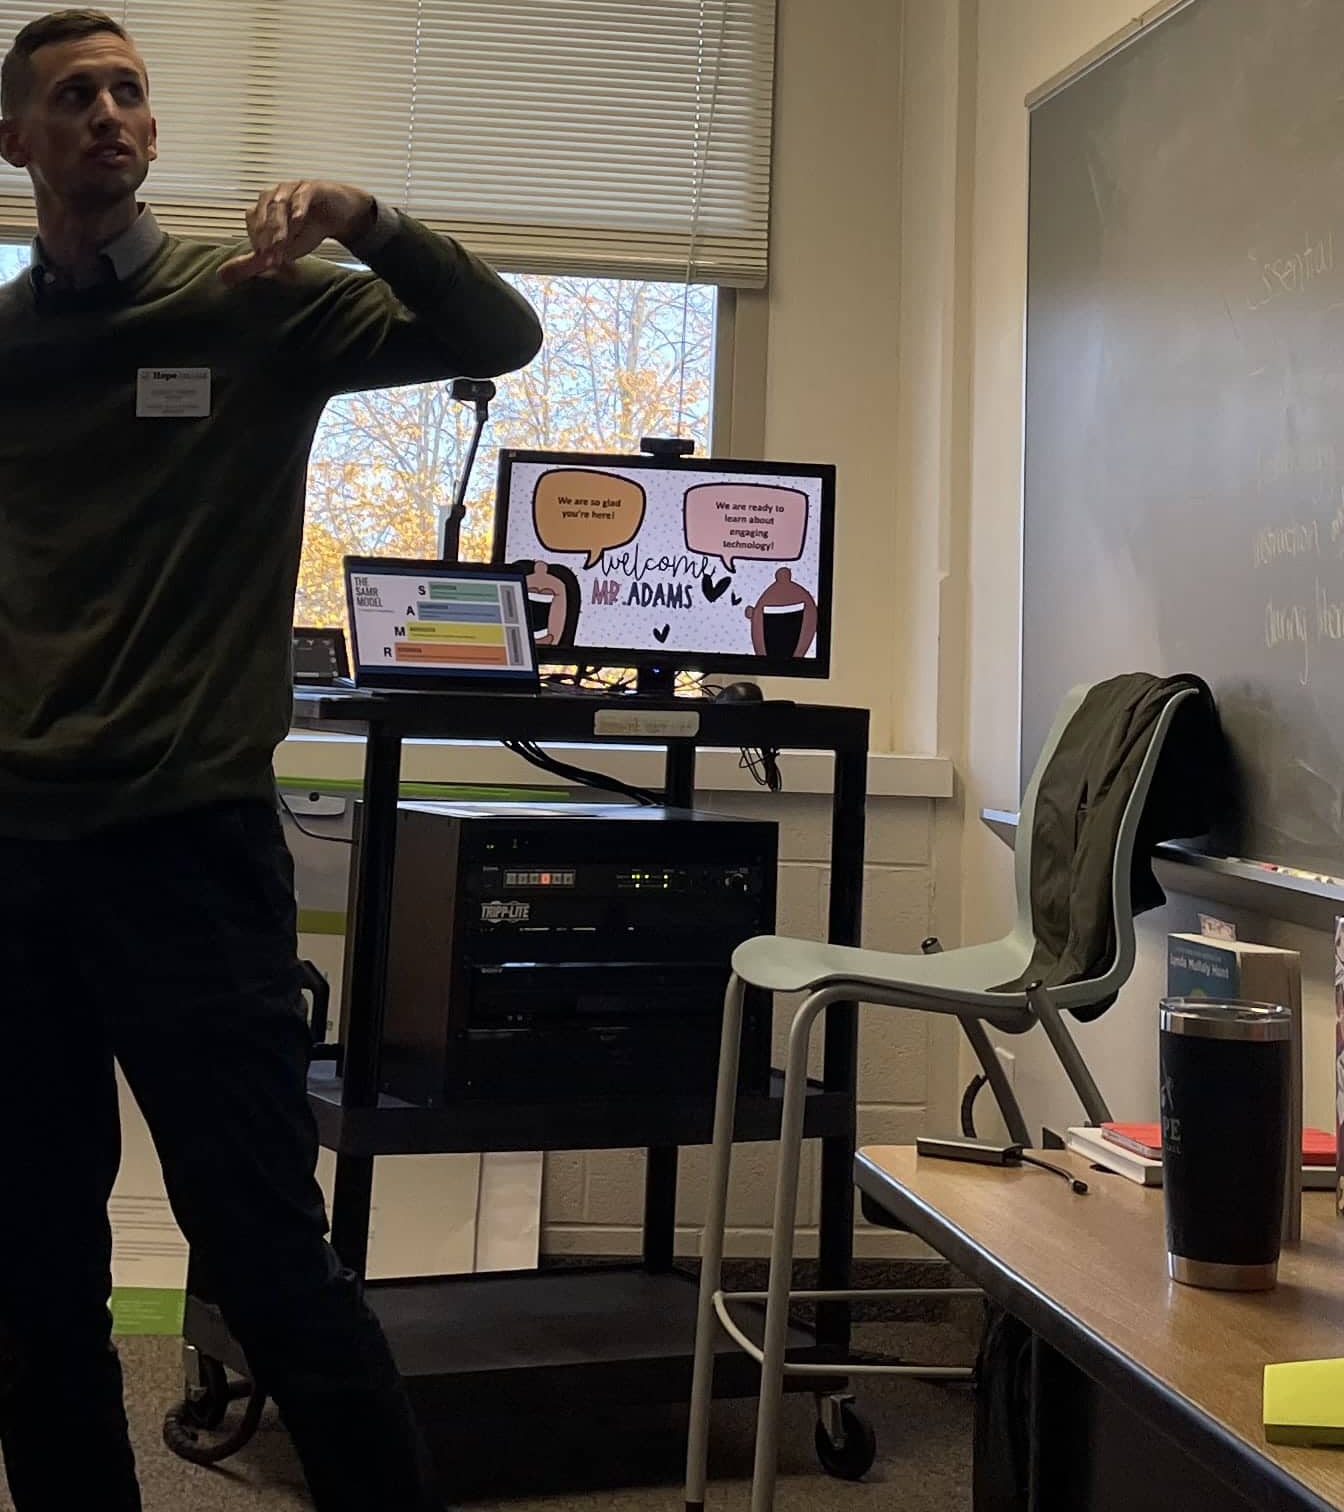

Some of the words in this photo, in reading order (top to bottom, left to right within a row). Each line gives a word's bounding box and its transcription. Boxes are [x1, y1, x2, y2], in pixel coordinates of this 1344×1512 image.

[557, 496, 573, 506] We
[574, 498, 589, 506] are
[590, 499, 601, 507] so
[602, 499, 622, 510] glad
[715, 501, 730, 511] We
[731, 504, 746, 512] are
[748, 504, 773, 515] ready
[775, 505, 785, 513] to
[561, 509, 590, 520] you're
[724, 514, 746, 524] learn
[748, 516, 774, 526] about
[729, 529, 769, 540] engaging
[722, 539, 775, 552] technology!
[354, 577, 368, 587] THE
[356, 587, 379, 598] SAMR
[418, 585, 426, 596] S
[357, 597, 383, 608] MODEL
[406, 606, 416, 617] A
[394, 626, 406, 637] M
[384, 647, 392, 658] R
